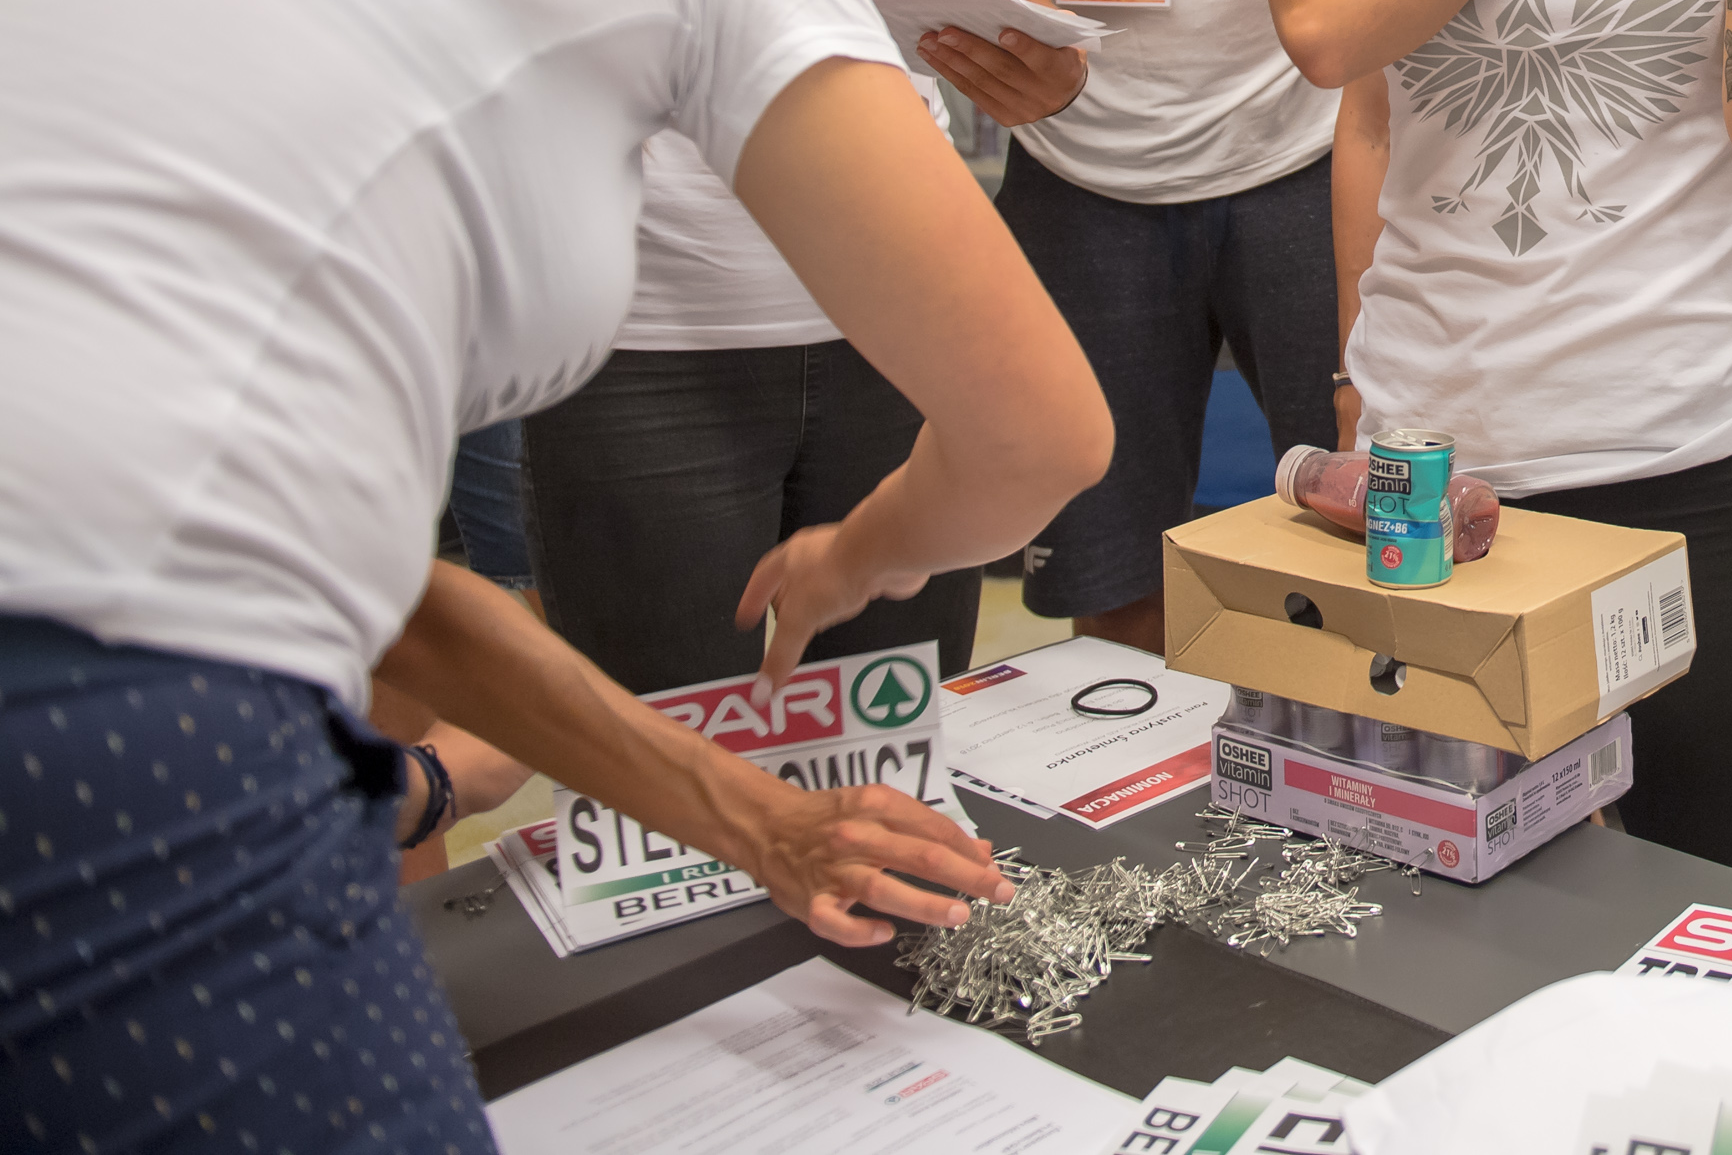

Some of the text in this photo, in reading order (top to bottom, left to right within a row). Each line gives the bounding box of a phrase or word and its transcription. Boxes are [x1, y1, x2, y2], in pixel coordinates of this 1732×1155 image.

[1369, 474, 1410, 493] tamin
[1368, 495, 1410, 514] HOT
[1367, 518, 1408, 534] GNEZ+B6
[660, 677, 836, 739] PAR
[1184, 701, 1209, 715] Pani
[1128, 710, 1183, 736] Justyna
[1222, 743, 1266, 767] OSHEE
[1220, 758, 1270, 788] vitamin
[1076, 770, 1174, 814] NOMINACJA
[1218, 779, 1272, 813] SHOT
[1331, 774, 1374, 796] WITAMINY
[1334, 787, 1376, 808] MINERAŁY
[1489, 804, 1514, 825] OSHEE
[614, 878, 752, 919] BERL
